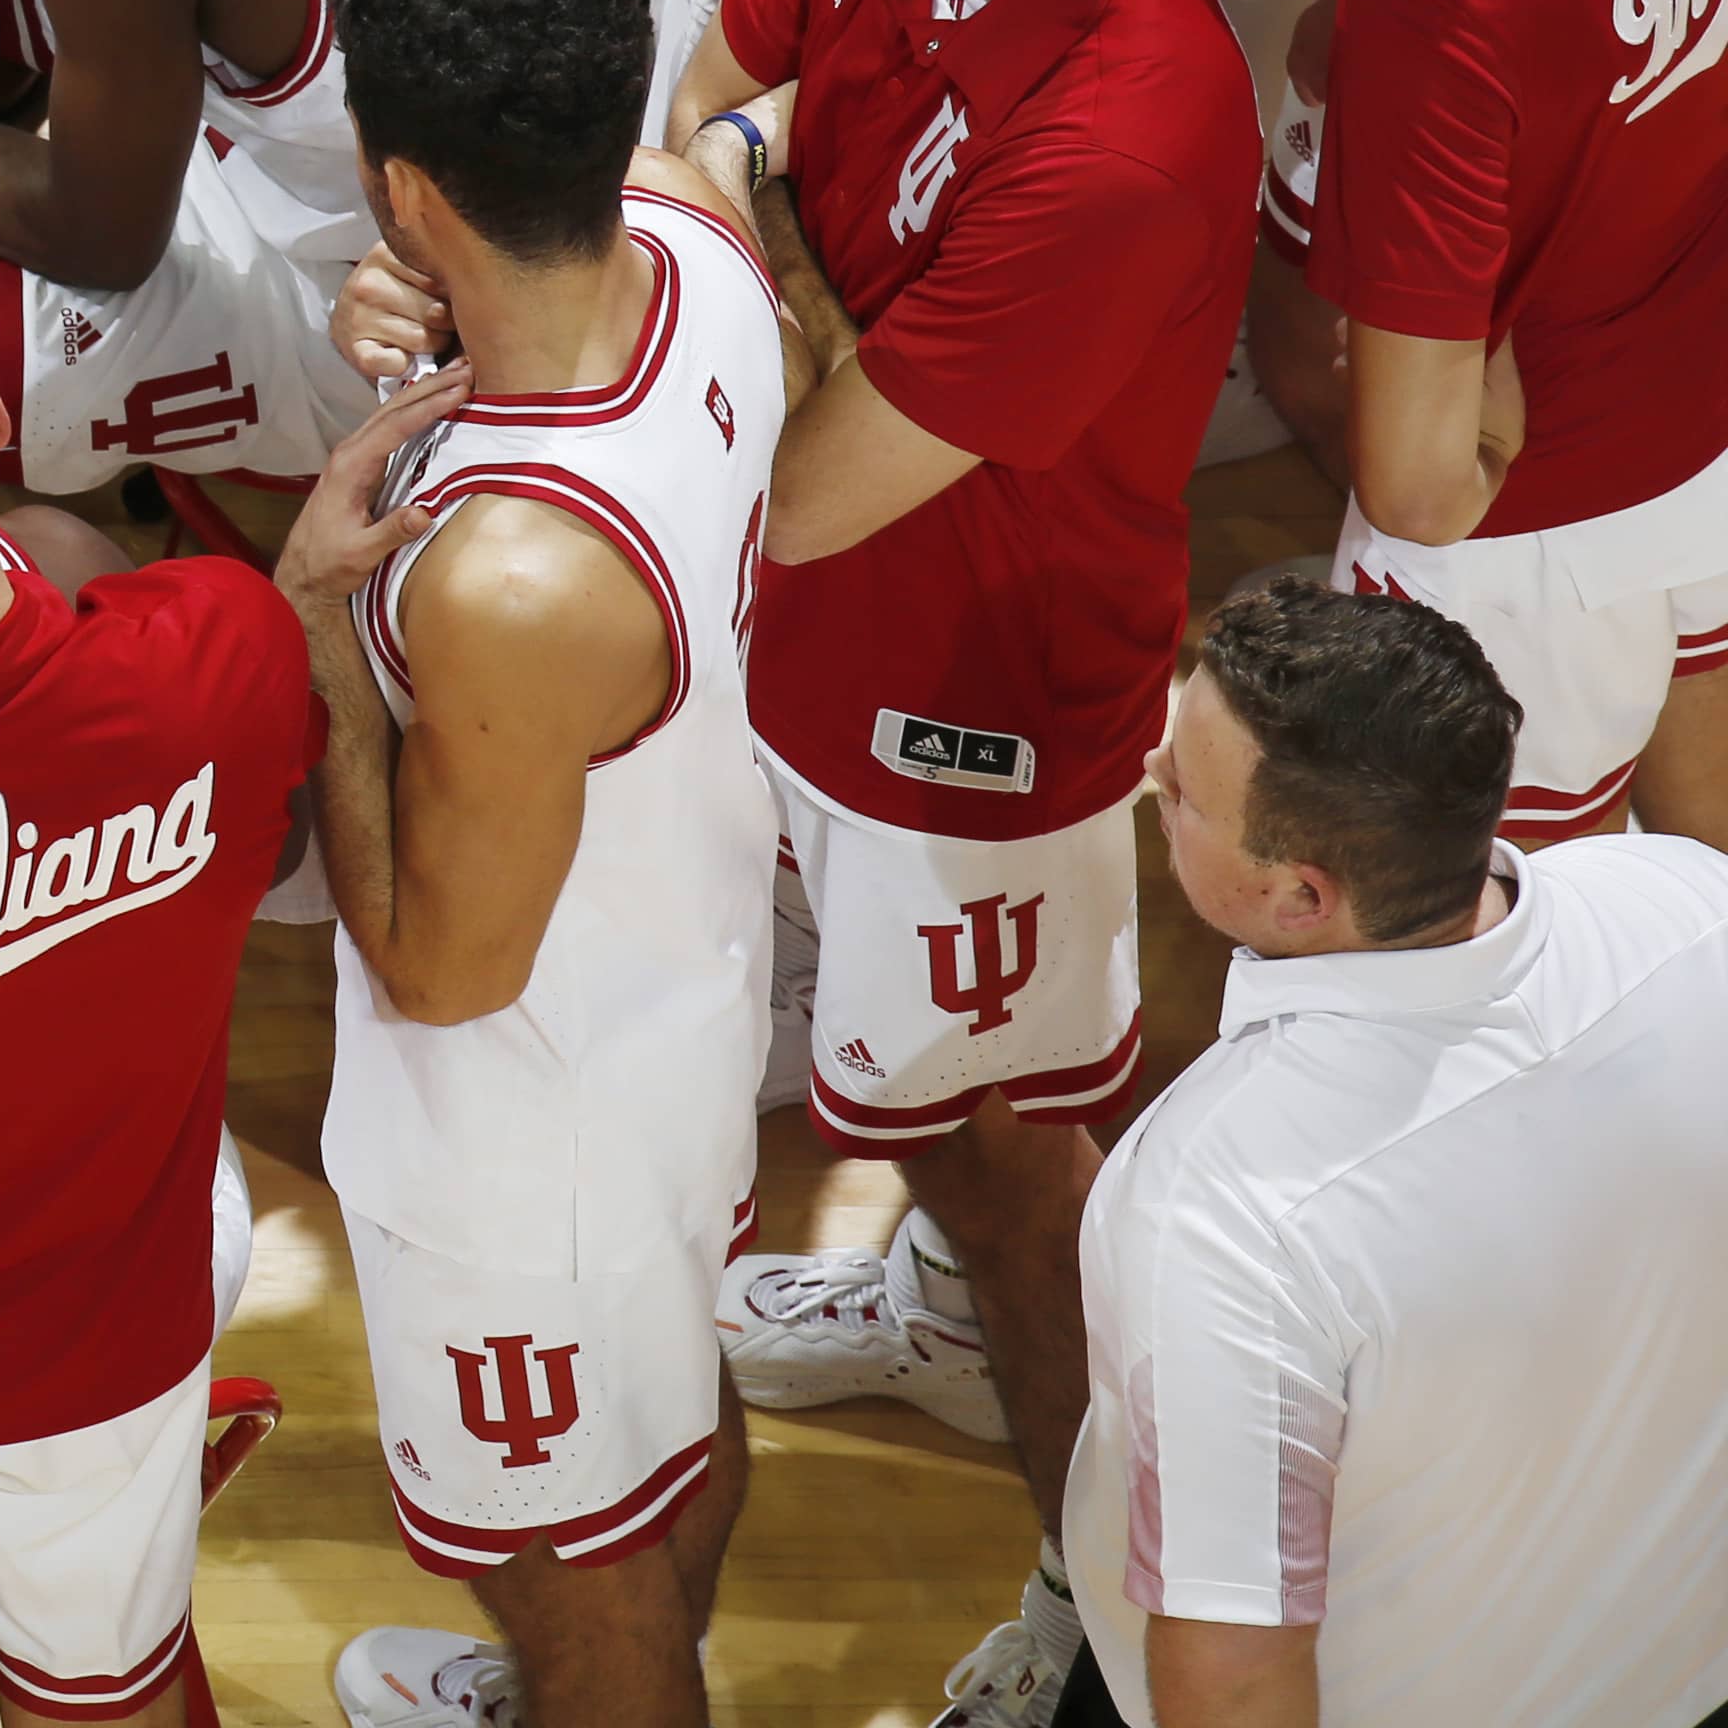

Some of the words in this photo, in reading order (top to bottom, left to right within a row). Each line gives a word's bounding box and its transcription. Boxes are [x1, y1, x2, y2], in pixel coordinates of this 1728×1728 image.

[61, 307, 78, 366] adidas
[909, 744, 951, 760] adidas
[976, 748, 998, 763] XL
[835, 1051, 886, 1078] adidas
